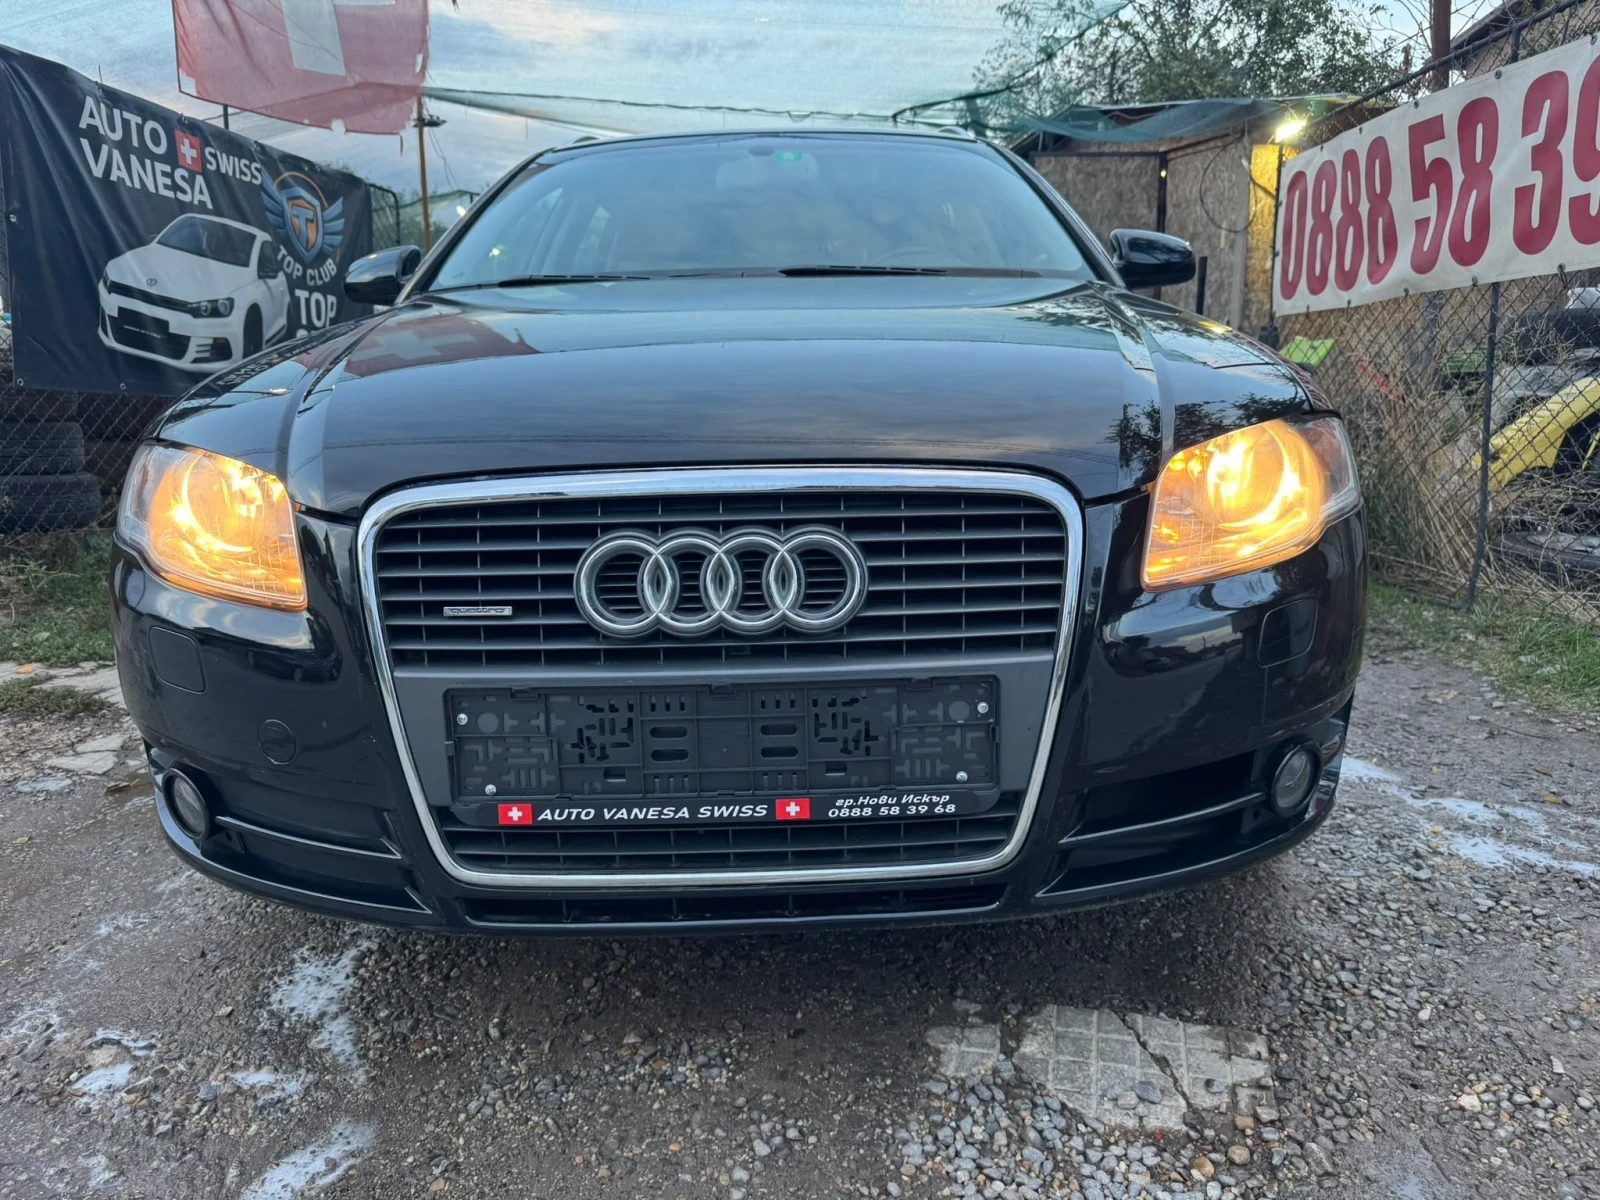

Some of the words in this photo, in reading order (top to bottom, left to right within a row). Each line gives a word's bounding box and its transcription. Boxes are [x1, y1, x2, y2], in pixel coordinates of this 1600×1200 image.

[78, 95, 168, 155] AUTO
[79, 137, 214, 209] VANESA
[204, 146, 262, 185] SWISS
[1280, 136, 1398, 300] 0888
[1408, 96, 1499, 275] 58
[276, 244, 303, 279] TOP
[306, 257, 337, 286] CLUB
[294, 288, 337, 328] TOP
[450, 607, 505, 615] quattro
[537, 808, 595, 821] AUTO
[602, 806, 690, 820] VANESA
[697, 804, 768, 818] SWISS
[828, 807, 872, 818] 0888
[878, 805, 900, 816] 58
[906, 804, 928, 815] 39
[934, 803, 956, 814] 68
[901, 793, 950, 804] Искър
